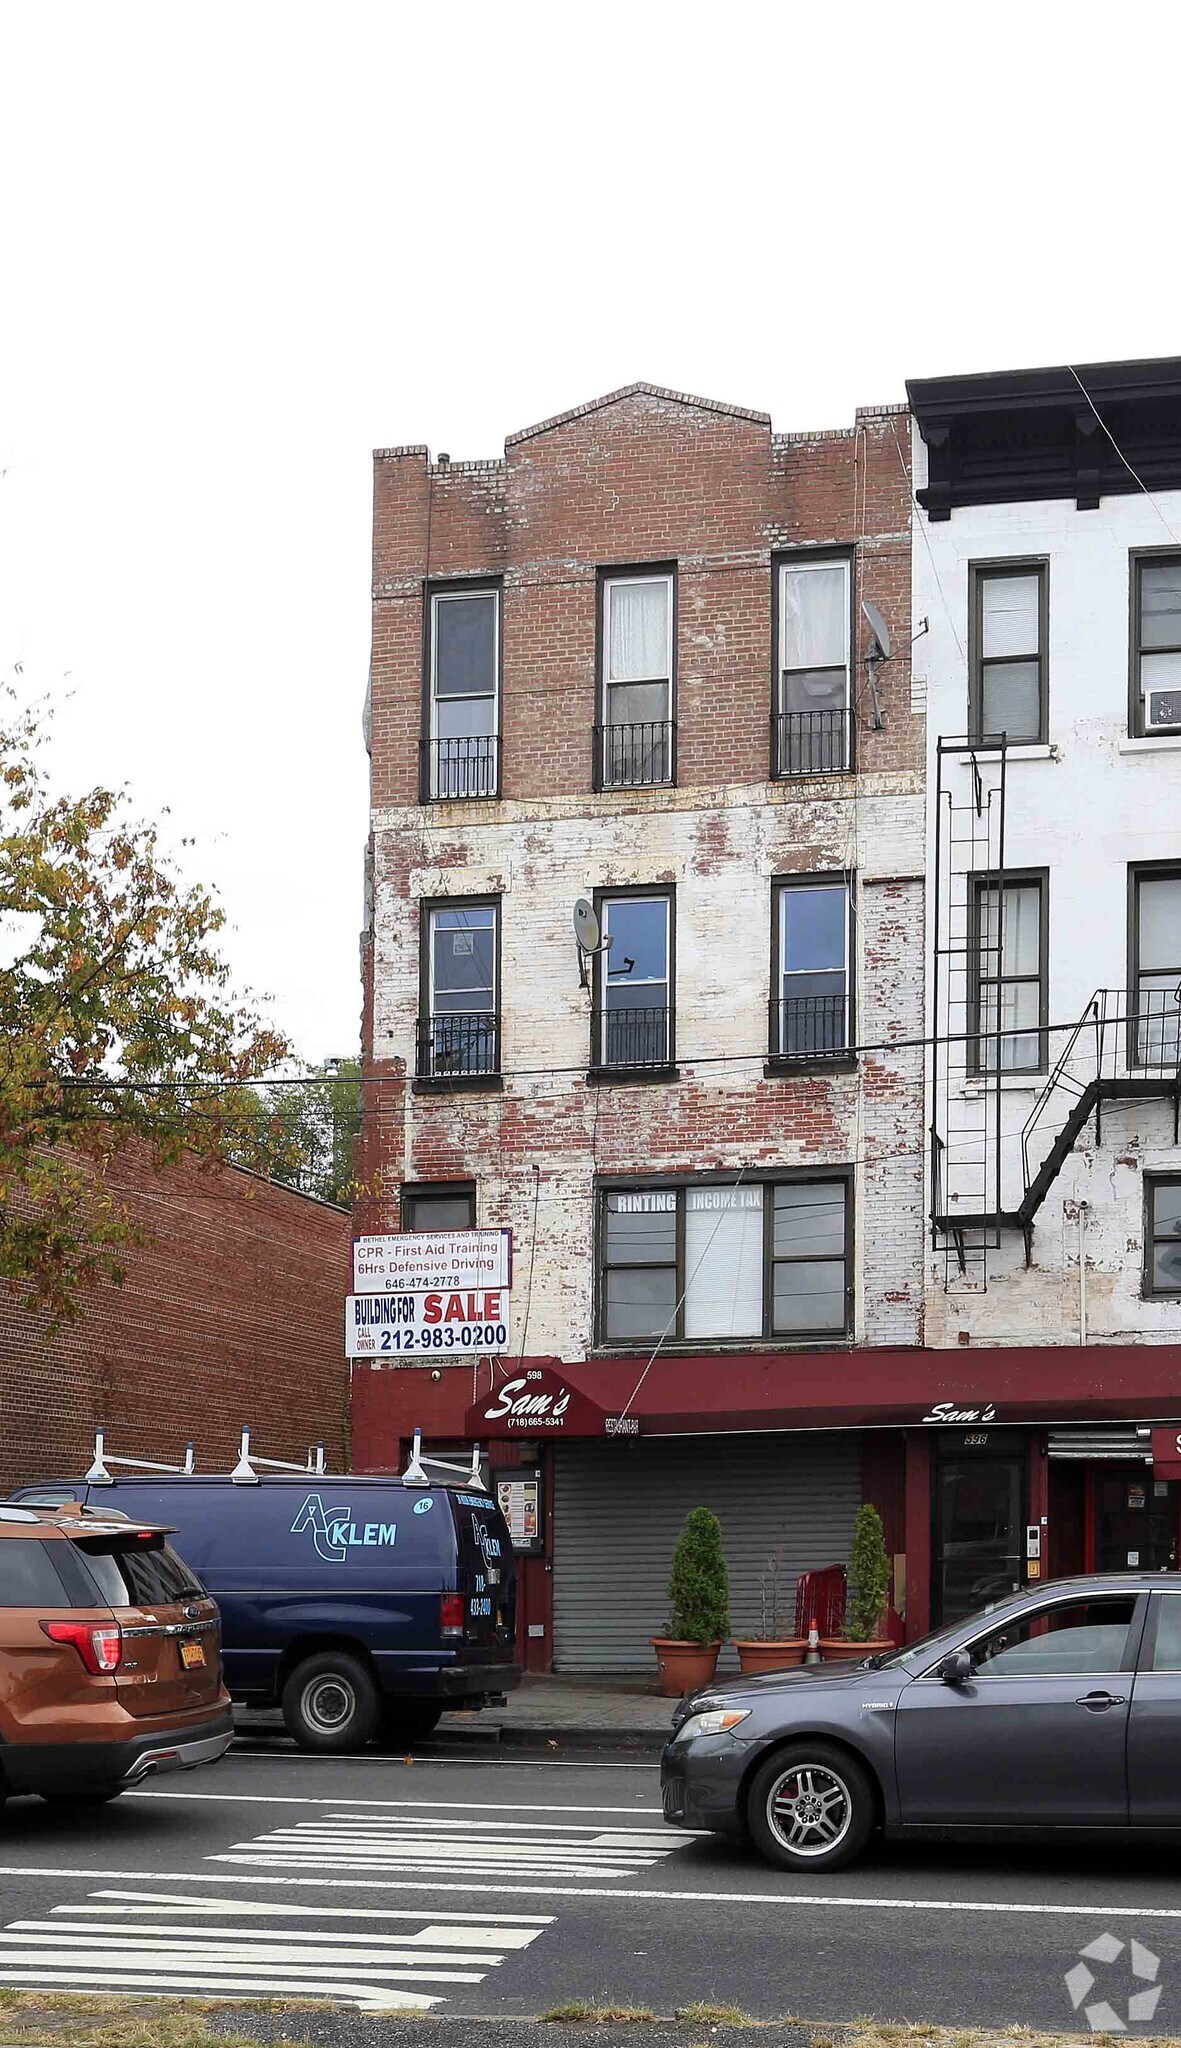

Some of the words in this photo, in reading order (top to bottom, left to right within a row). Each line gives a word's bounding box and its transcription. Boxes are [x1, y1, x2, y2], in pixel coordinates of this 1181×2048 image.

[618, 1194, 676, 1212] RINTING
[692, 1192, 736, 1210] INCOME
[740, 1190, 761, 1207] TAX
[471, 1230, 499, 1238] TRAINING
[357, 1247, 384, 1258] CPR
[395, 1245, 422, 1256] First
[425, 1243, 445, 1255] Aid
[449, 1241, 498, 1255] Training
[358, 1262, 385, 1274] 6Hrs
[389, 1260, 448, 1273] Defensive
[451, 1257, 494, 1270] Driving
[385, 1276, 460, 1289] 646-474-2778
[355, 1297, 396, 1326] BUILDING
[398, 1296, 415, 1323] FOR
[423, 1293, 501, 1324] SALE
[358, 1327, 371, 1338] CALL
[381, 1324, 507, 1350] 212-983-0200
[356, 1339, 376, 1351] OWNER
[526, 1371, 542, 1380] 598
[484, 1379, 571, 1419] Sam's
[922, 1403, 996, 1422] Sam's
[966, 1435, 986, 1444] 596
[419, 1502, 429, 1510] 16
